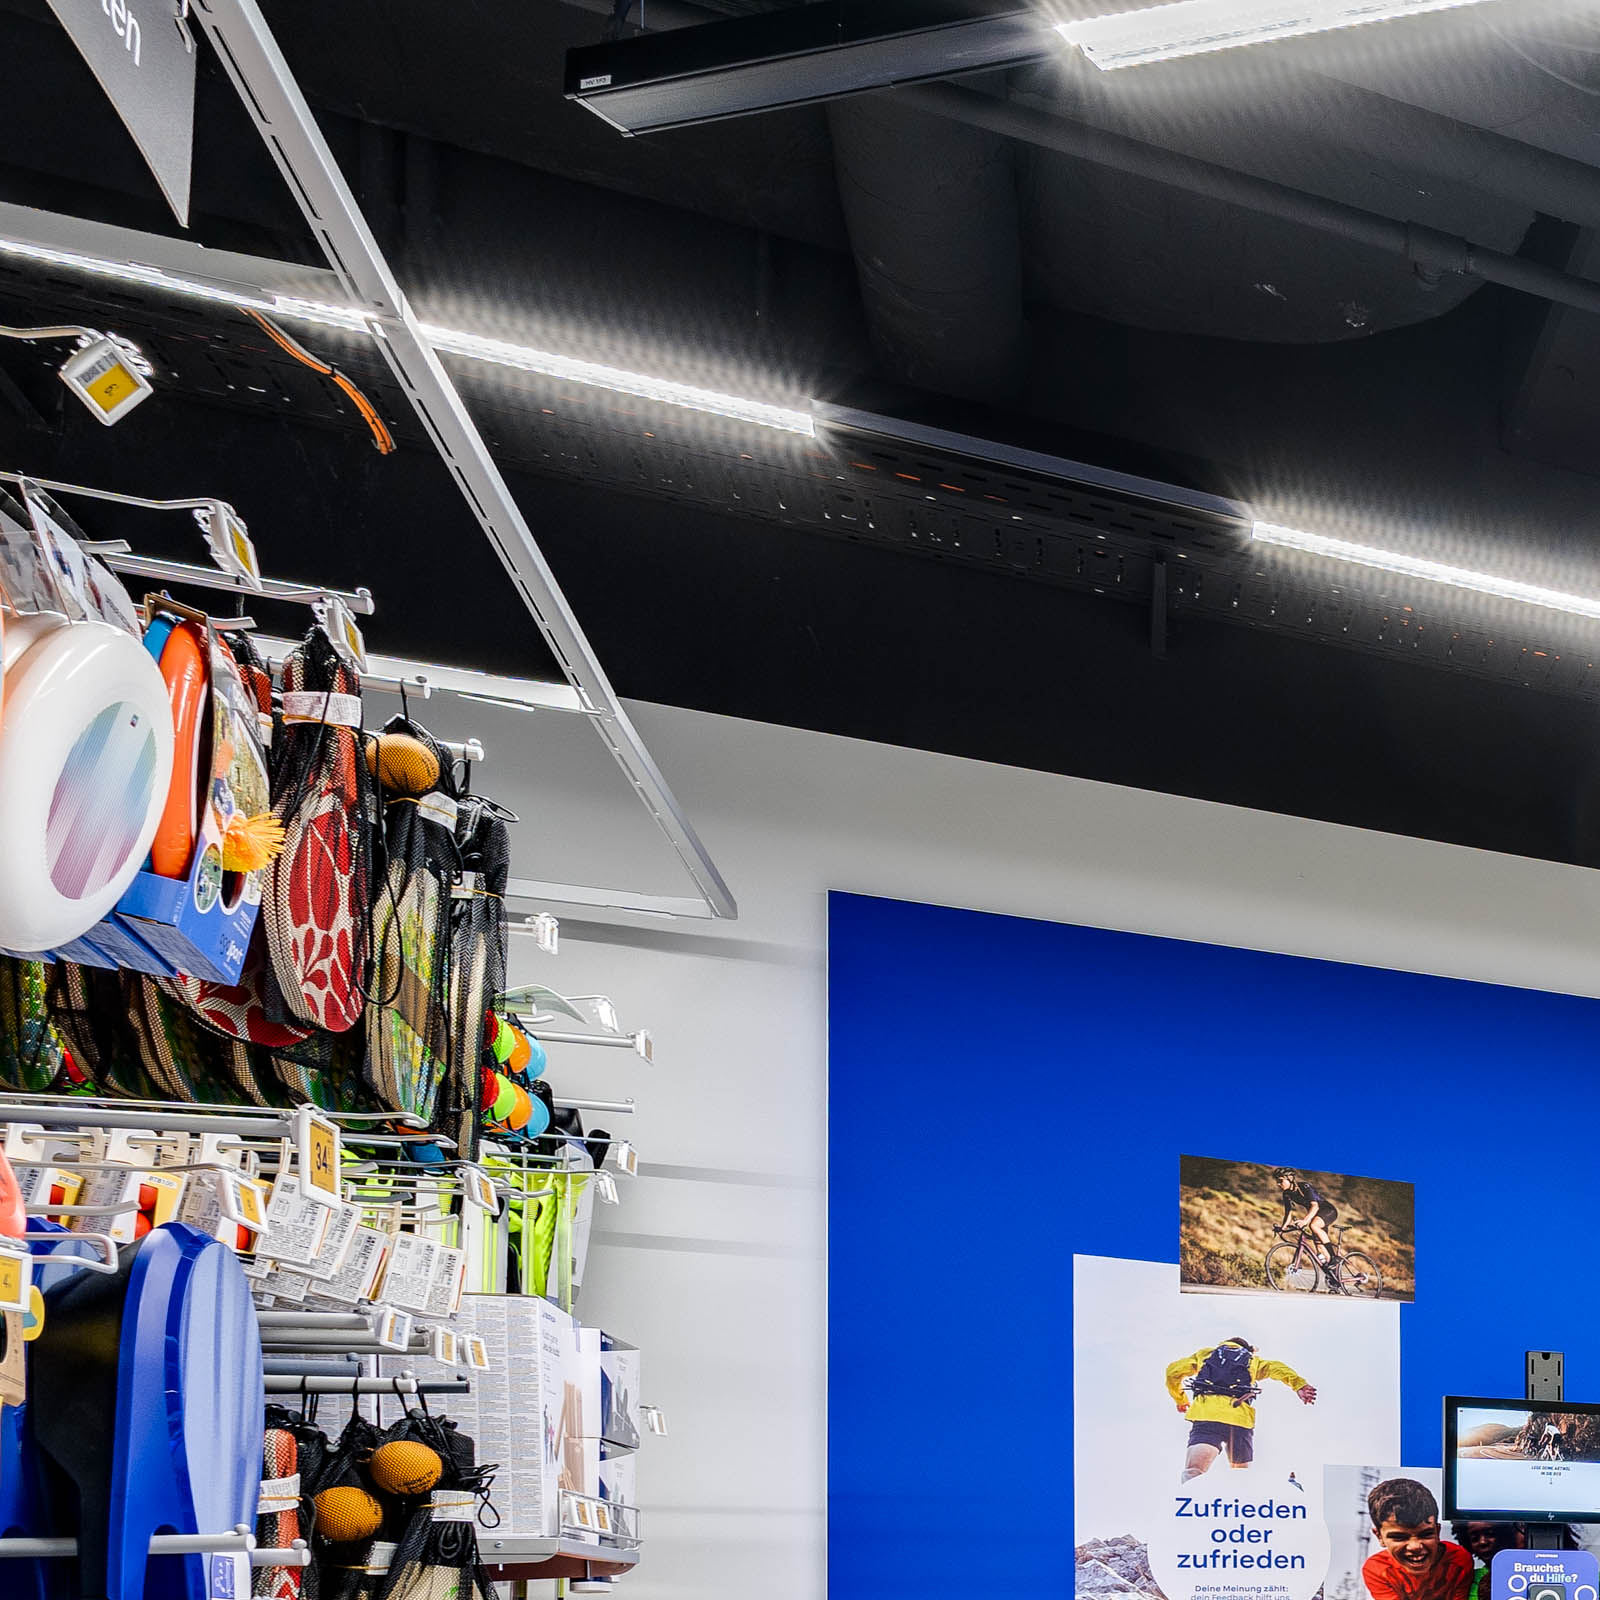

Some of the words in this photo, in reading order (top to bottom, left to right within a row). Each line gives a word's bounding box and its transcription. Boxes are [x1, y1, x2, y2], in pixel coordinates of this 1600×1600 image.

[1175, 1497, 1307, 1519] Zufrieden
[1211, 1524, 1273, 1543] oder
[1177, 1549, 1305, 1569] zufrieden
[1514, 1562, 1564, 1573] Brauchst
[1529, 1573, 1544, 1583] du
[1546, 1573, 1578, 1583] Hilfe?
[1195, 1585, 1221, 1593] Deine
[1223, 1586, 1262, 1594] Meinung
[1264, 1585, 1289, 1593] zählt:
